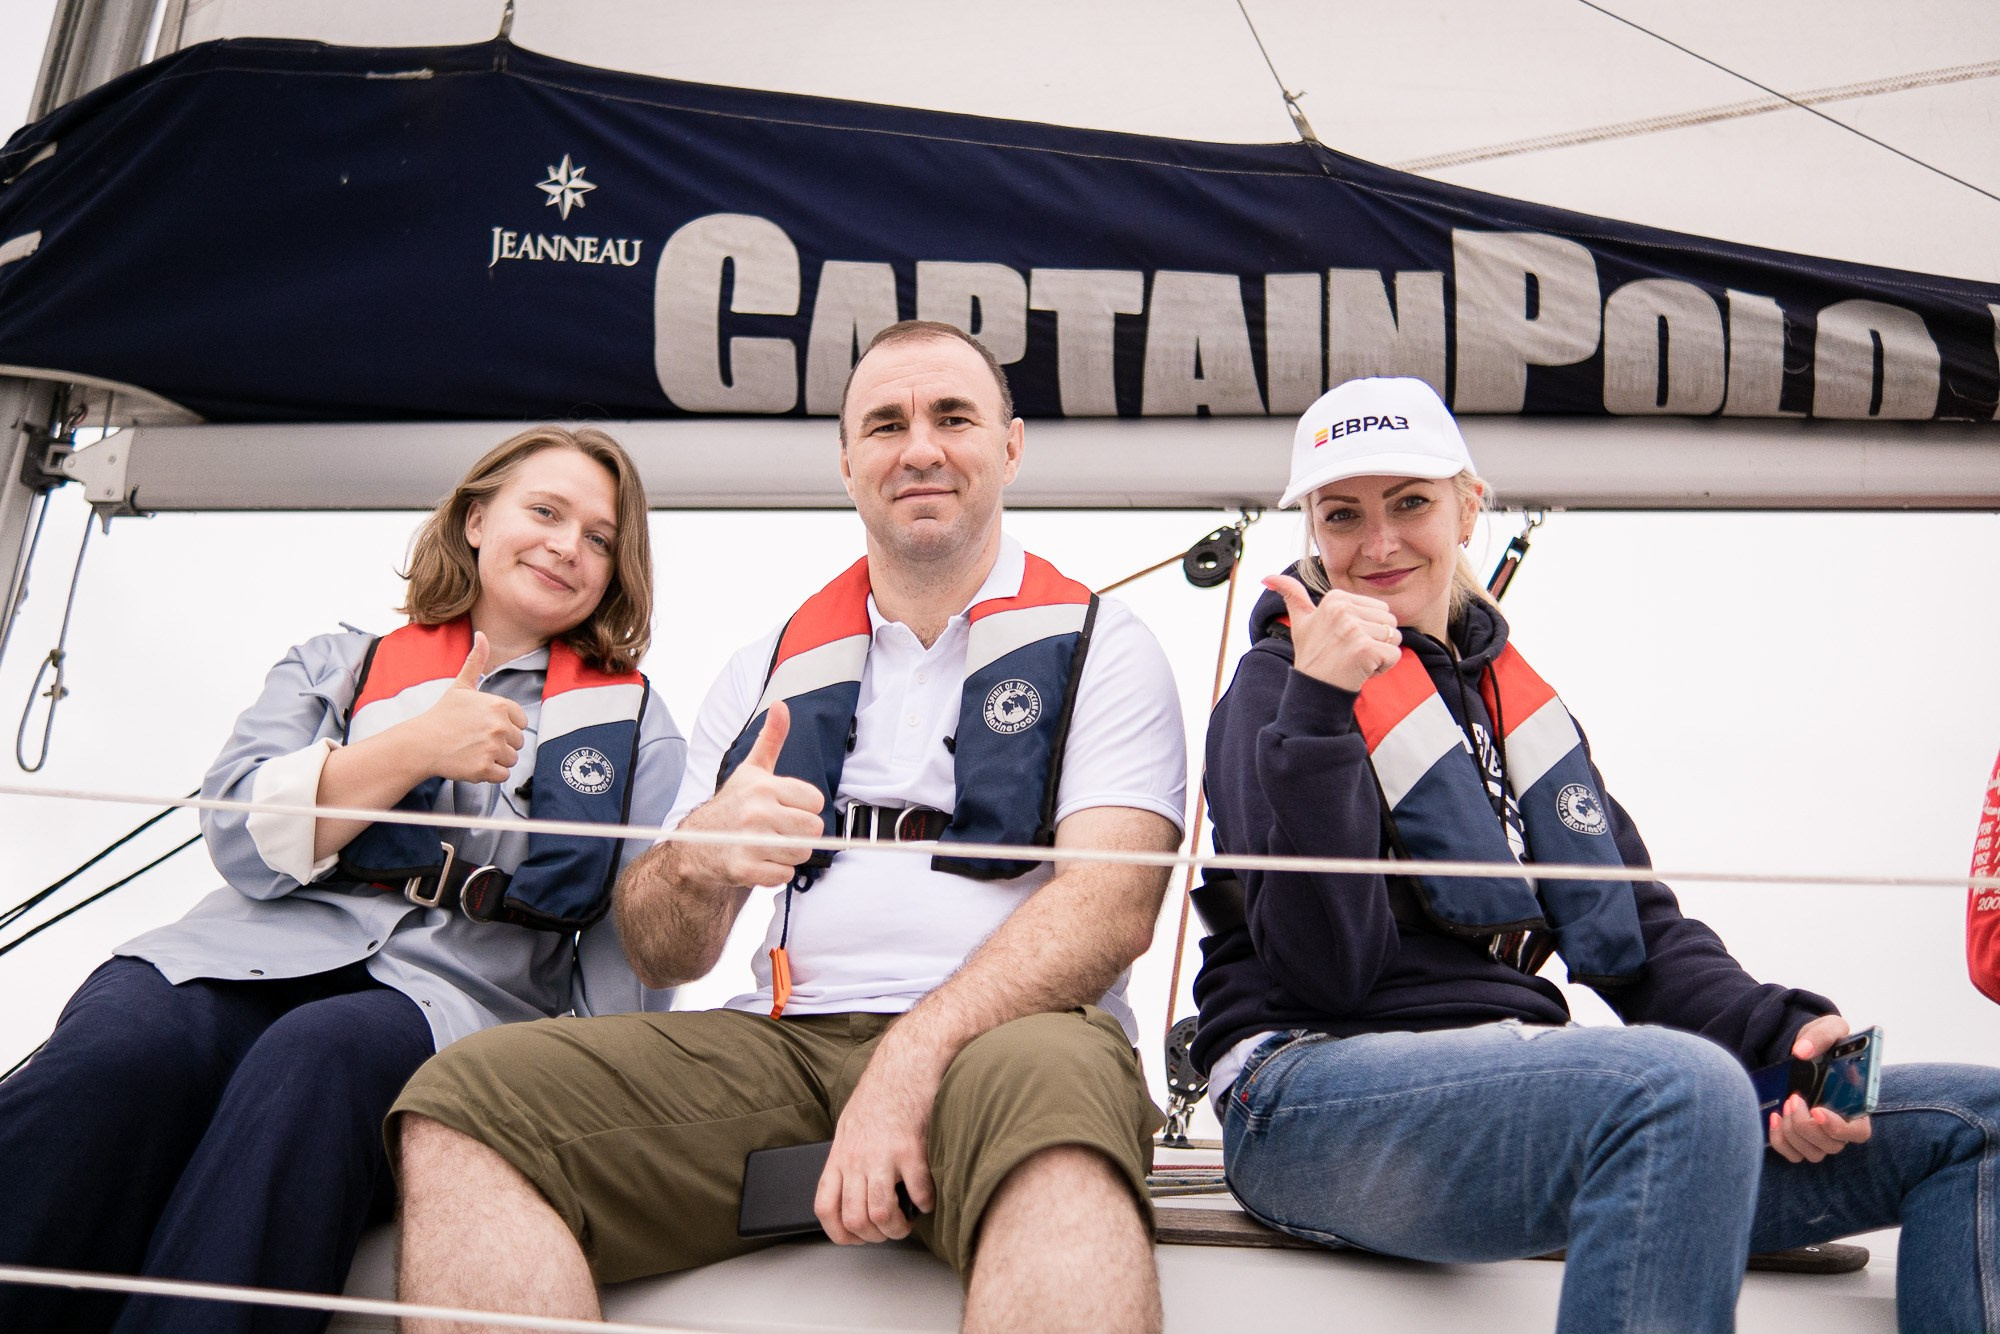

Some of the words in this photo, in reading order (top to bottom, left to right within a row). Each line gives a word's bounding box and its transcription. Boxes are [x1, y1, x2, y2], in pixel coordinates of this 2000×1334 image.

[489, 227, 642, 267] JEANNEAU
[1332, 415, 1409, 440] ЕВРАЗ
[988, 686, 1004, 704] SPIRIT
[1005, 682, 1013, 690] OF
[1016, 682, 1028, 692] THE
[985, 710, 1035, 732] Marinepool
